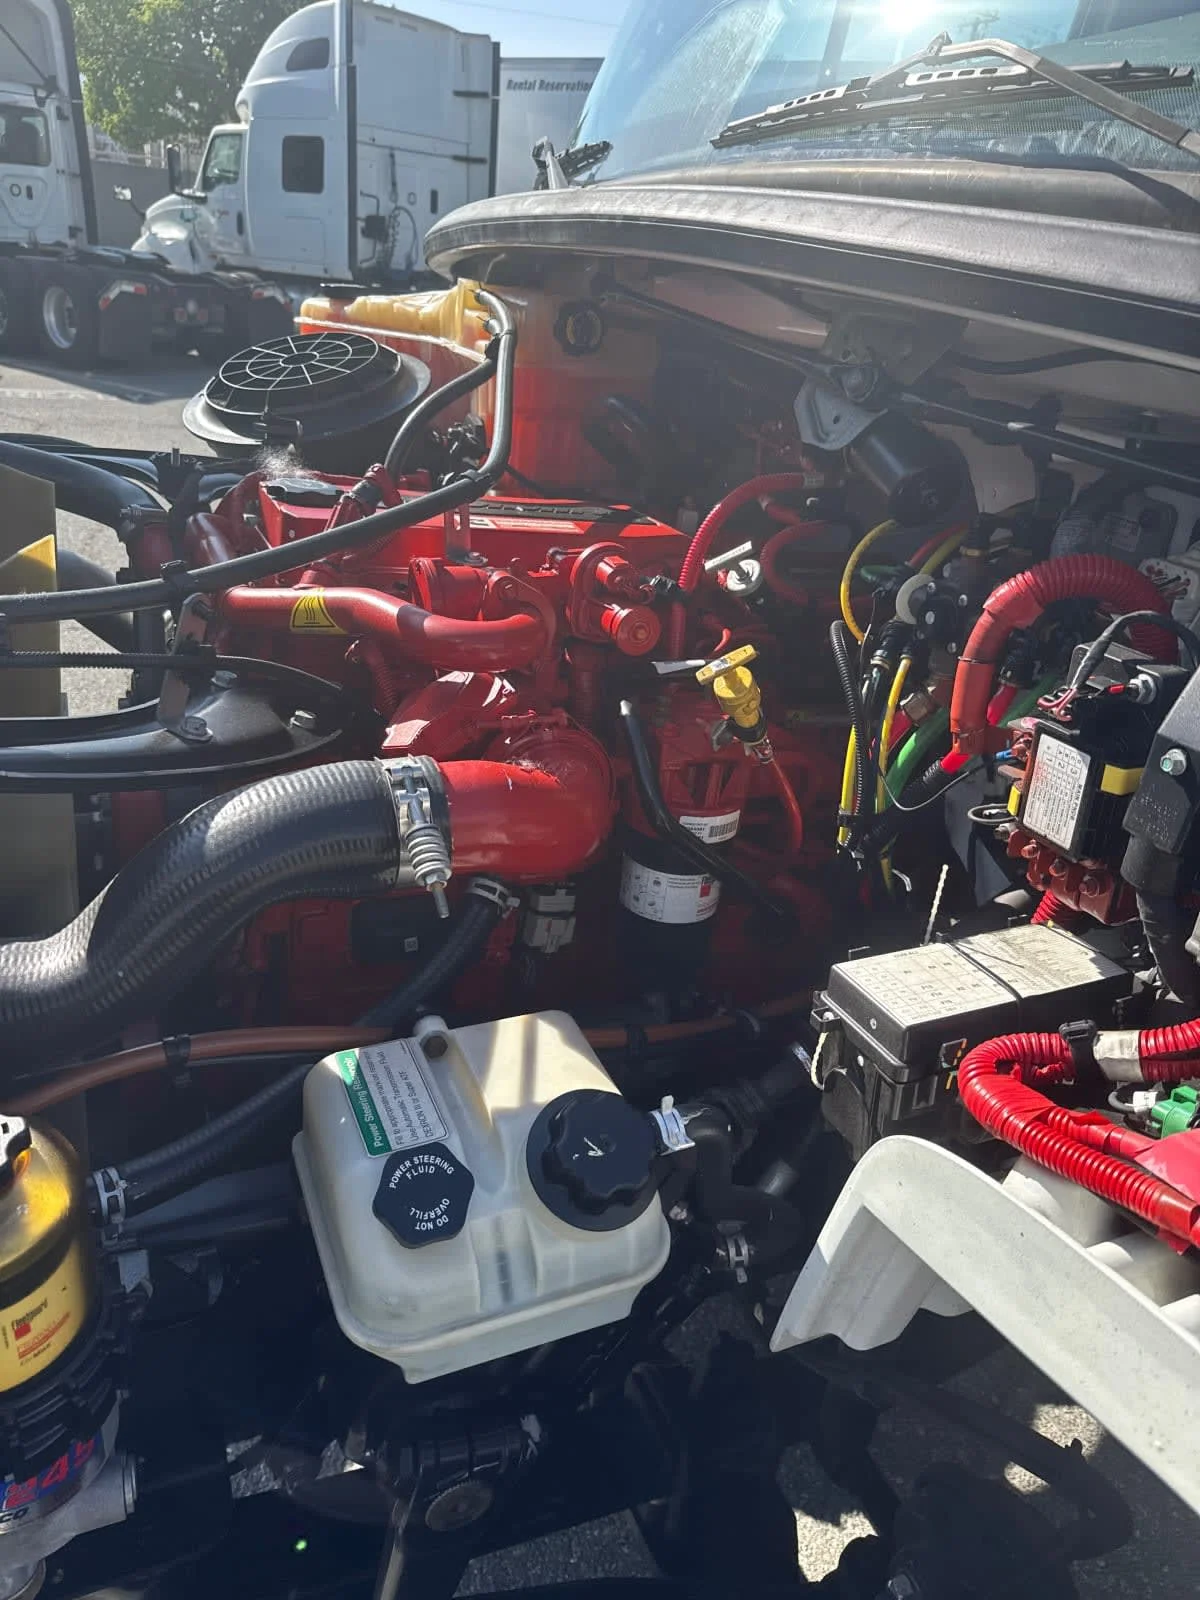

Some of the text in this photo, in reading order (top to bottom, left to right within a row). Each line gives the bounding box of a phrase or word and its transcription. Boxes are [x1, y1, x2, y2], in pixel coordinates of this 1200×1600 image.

[506, 80, 537, 91] Rental
[384, 1065, 401, 1099] Transmission
[398, 1070, 409, 1081] ATF
[404, 1080, 416, 1097] Super
[358, 1090, 375, 1122] Steering
[369, 1122, 384, 1148] Power
[407, 1127, 419, 1140] Use
[389, 1155, 455, 1189] POWER STEERING
[405, 1165, 435, 1179] FLUID
[409, 1198, 450, 1220] OVERFILL
[415, 1214, 449, 1230] DO NOT
